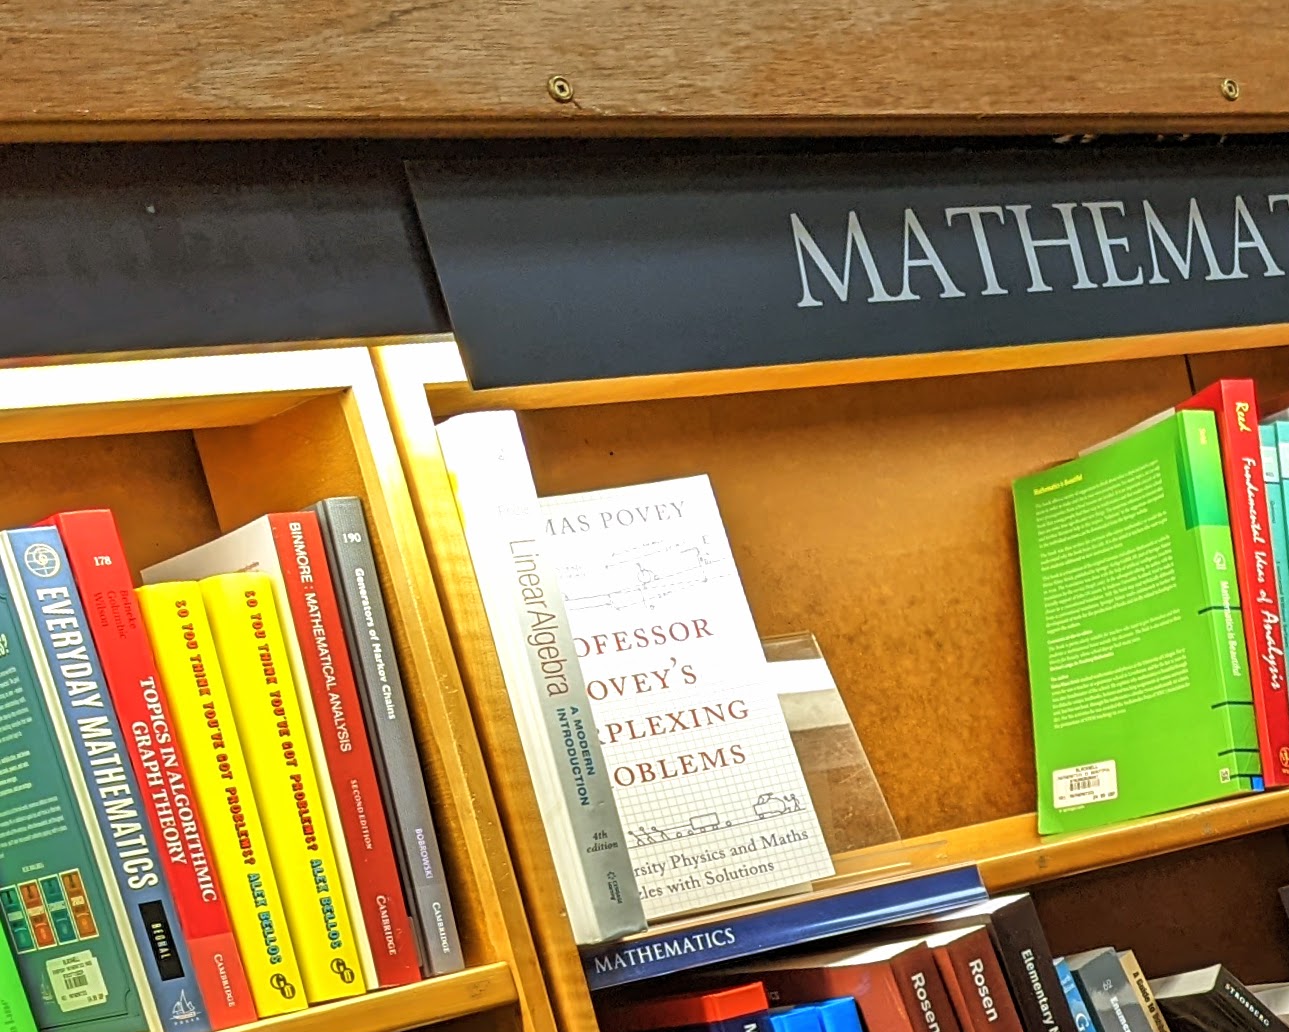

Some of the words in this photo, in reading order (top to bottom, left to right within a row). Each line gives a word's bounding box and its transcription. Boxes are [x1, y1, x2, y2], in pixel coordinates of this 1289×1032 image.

[600, 501, 684, 528] POVEY
[1242, 458, 1265, 544] Fundamental
[94, 556, 112, 566] 178
[1254, 550, 1268, 583] Ideas
[245, 591, 257, 608] SO
[1257, 588, 1273, 604] of
[251, 613, 266, 639] YOU
[289, 522, 313, 583] BINMORE
[304, 592, 338, 690] MATHEMATICAL
[329, 692, 352, 752] ANALYSIS
[508, 538, 547, 610] Linear
[529, 610, 570, 698] Algebra
[258, 644, 278, 685] THINK
[1261, 610, 1284, 690] Analysis
[587, 657, 697, 700] OVEY'S
[270, 690, 291, 738] YOU'VE
[570, 706, 579, 715] A
[596, 700, 749, 745] PLEXING
[36, 586, 104, 707] EVERYDAY
[76, 715, 158, 890] MATHEMATICS
[282, 741, 298, 767] GOT
[557, 708, 590, 806] INTRODUCTION
[573, 720, 596, 776] MODERN
[611, 744, 746, 788] OBLEMS
[132, 720, 162, 788] GRAPH
[153, 789, 188, 866] THEORY
[139, 677, 171, 744] TOPICS
[160, 747, 178, 768] IN
[169, 765, 217, 903] ALGORITHMIC
[586, 840, 618, 854] edition
[592, 830, 608, 841] 4th
[670, 847, 726, 871] Physics
[731, 840, 757, 852] and
[761, 829, 809, 850] Maths
[310, 859, 329, 894] ALEX
[669, 876, 702, 894] with
[704, 862, 774, 886] Solutions
[320, 896, 343, 950] BELLOS
[594, 927, 736, 974] MATHEMATICS
[1020, 948, 1055, 1025] Elementary
